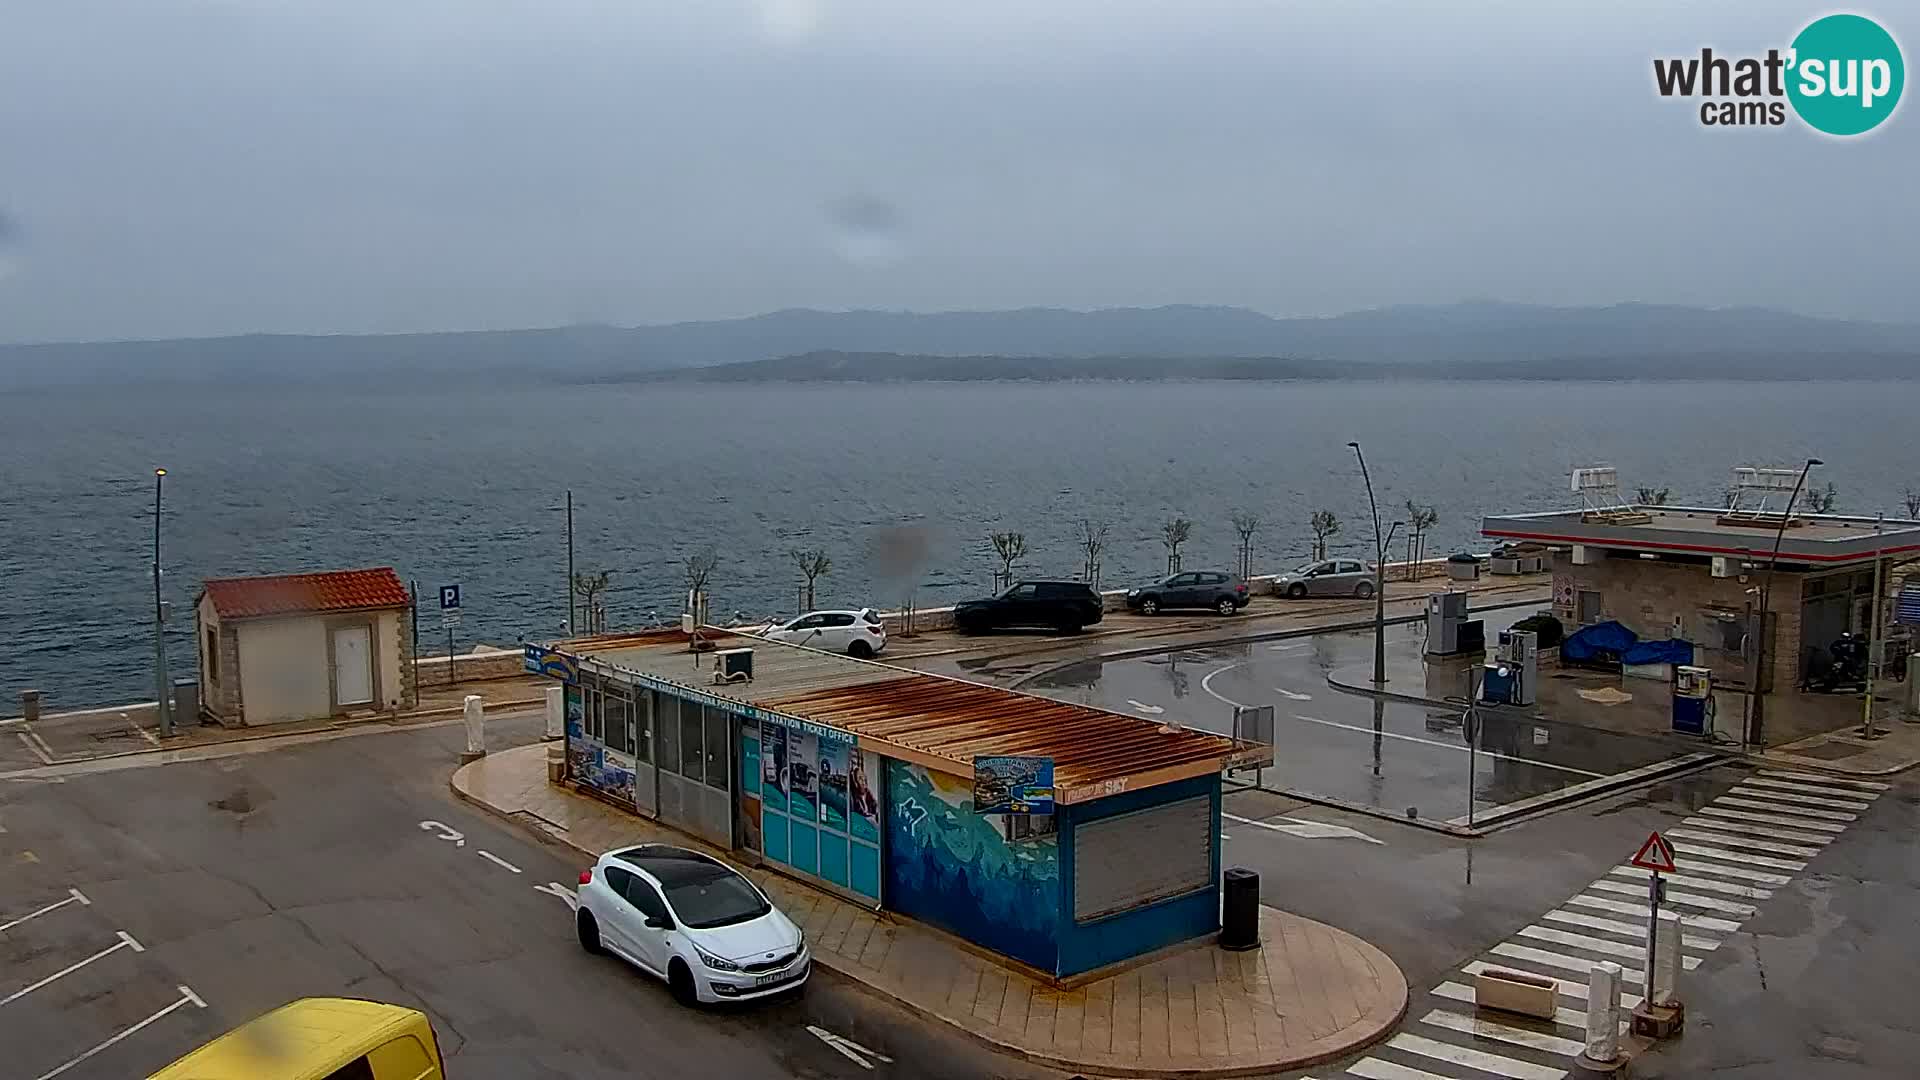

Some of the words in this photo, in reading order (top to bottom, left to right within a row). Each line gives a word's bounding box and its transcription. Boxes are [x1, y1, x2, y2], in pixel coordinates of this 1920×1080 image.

[443, 589, 455, 606] P
[717, 699, 745, 715] POSTAJA
[755, 709, 770, 721] BUS
[771, 713, 801, 729] STATION
[803, 721, 828, 737] TICKET
[828, 729, 854, 744] OFFICE
